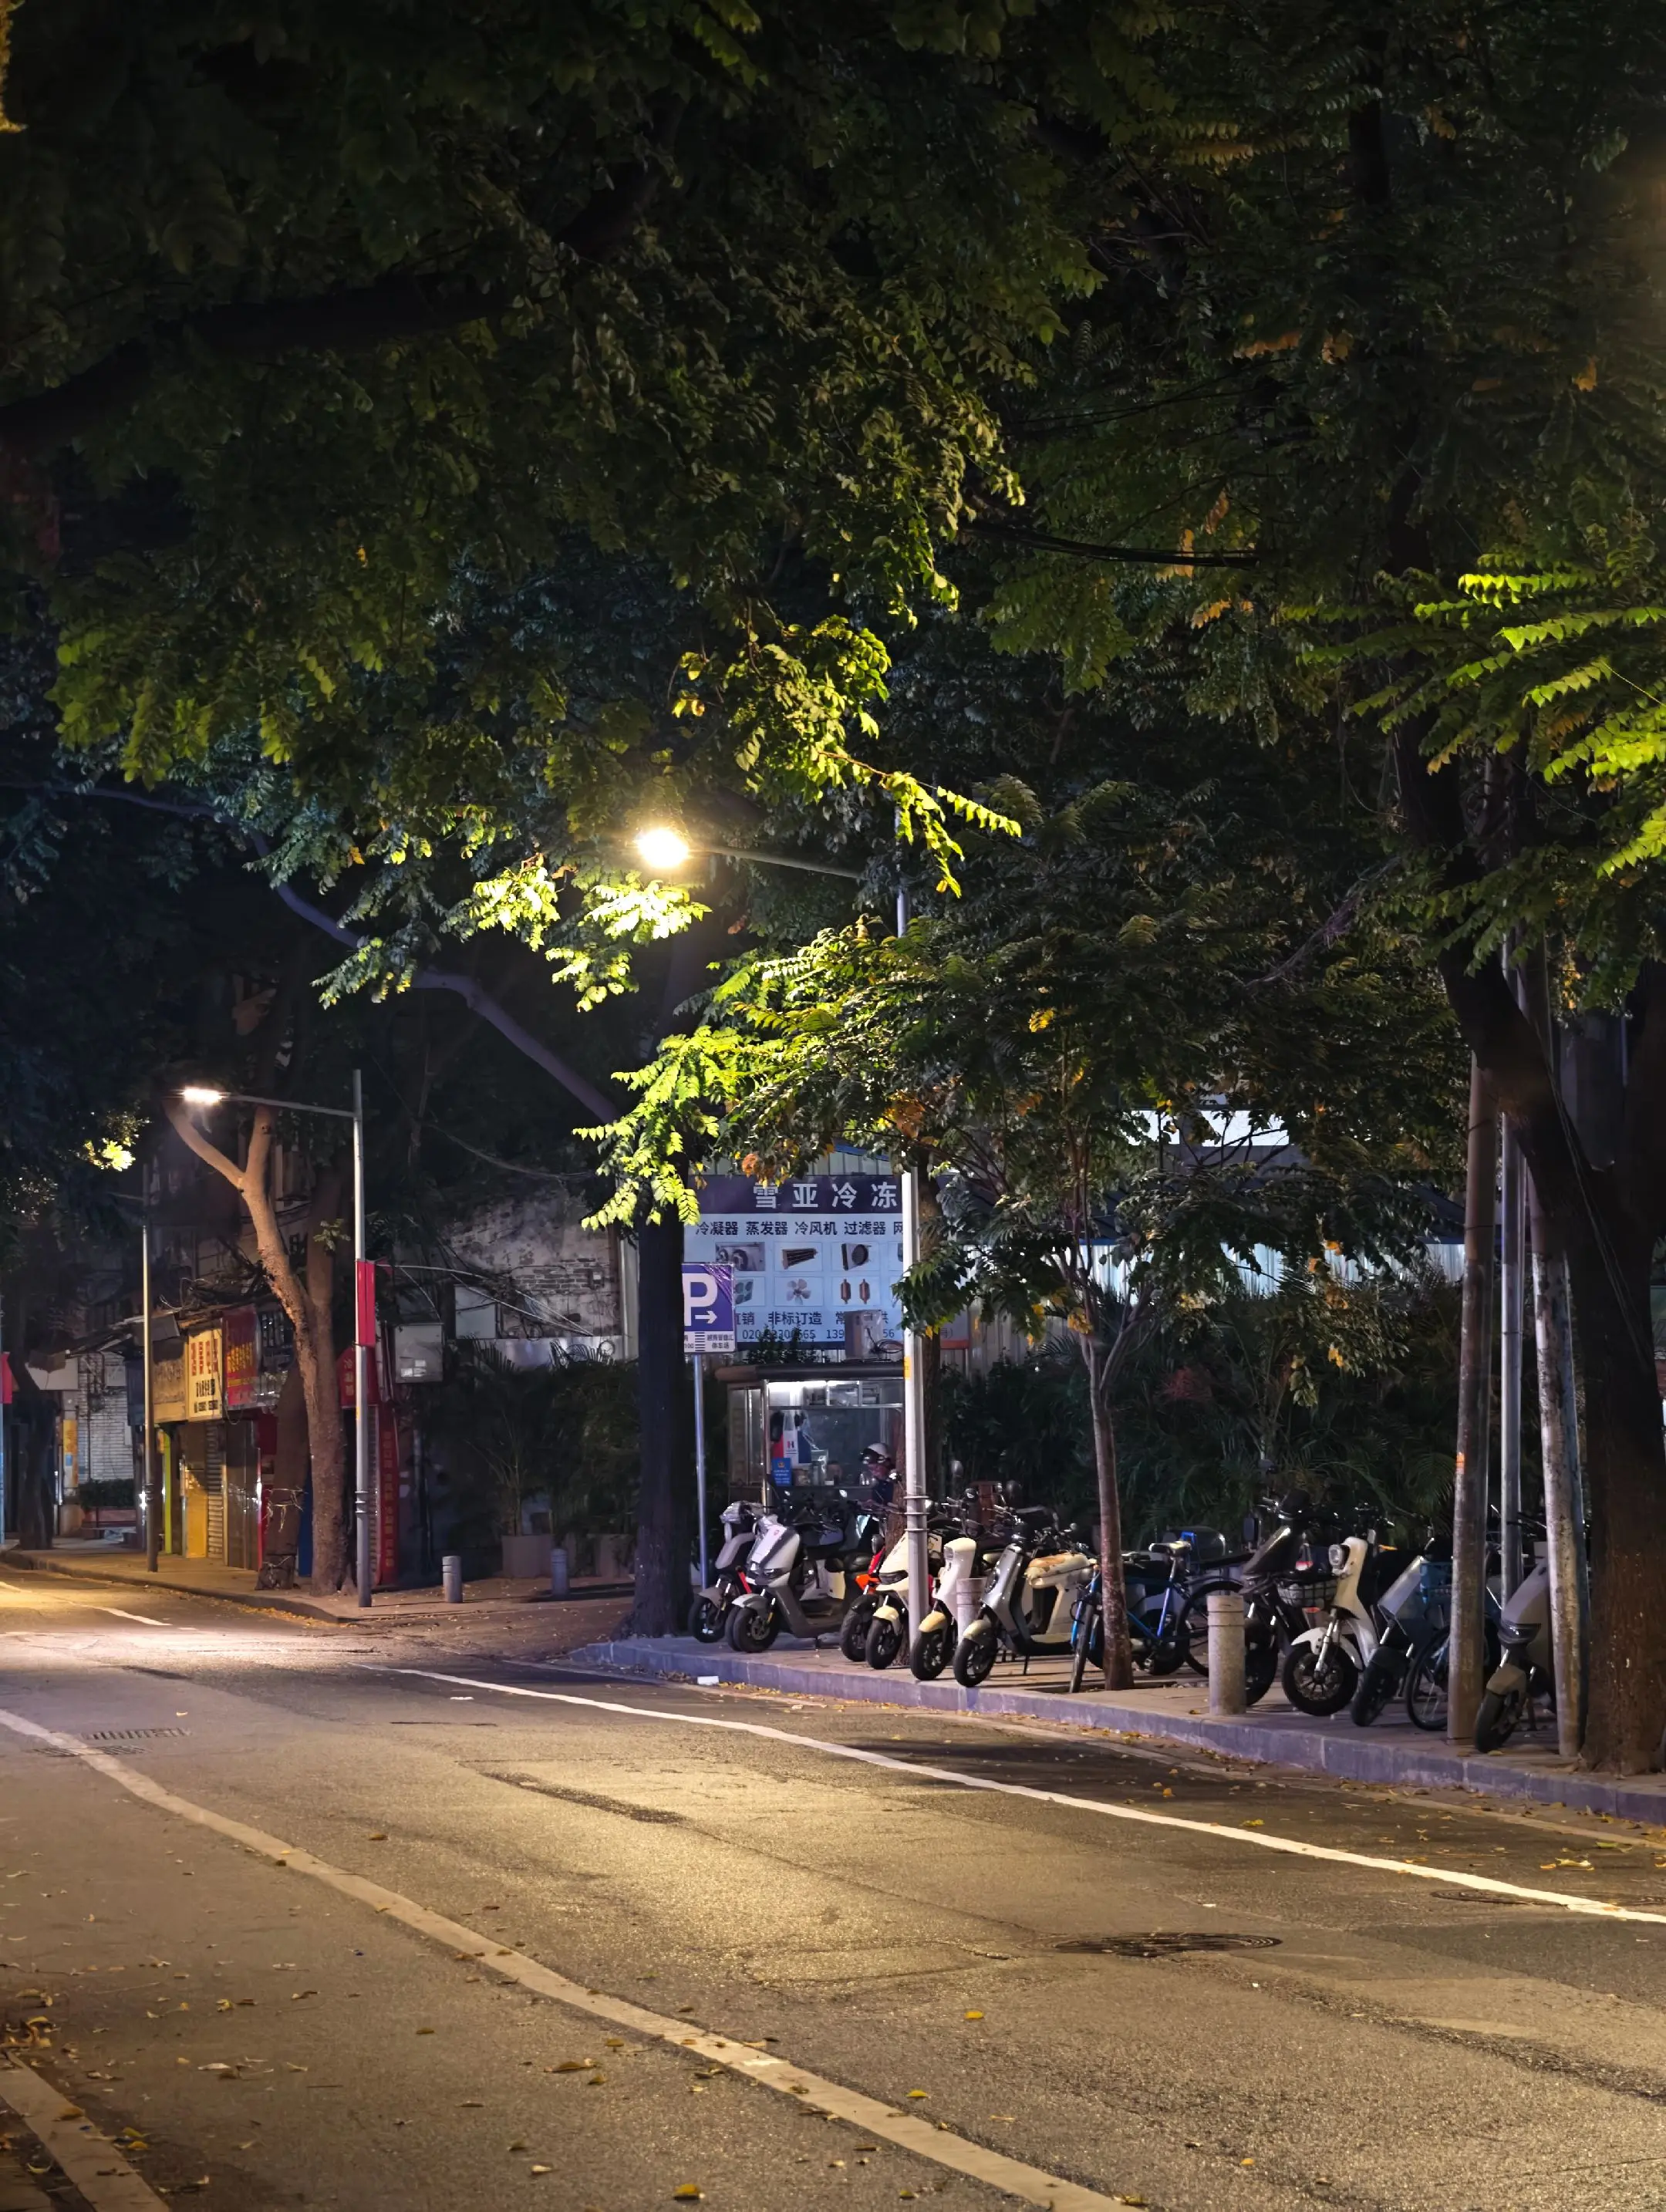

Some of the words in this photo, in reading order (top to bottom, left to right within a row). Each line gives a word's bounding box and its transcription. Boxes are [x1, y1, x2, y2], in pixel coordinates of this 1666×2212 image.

[753, 1182, 898, 1209] 雪亚冷冻
[696, 1221, 739, 1236] 冷凝器
[746, 1221, 788, 1236] 蒸发器
[794, 1221, 838, 1236] 冷风机
[844, 1221, 886, 1236] 过滤器
[682, 1273, 718, 1327] P
[767, 1311, 822, 1326] 非标订造
